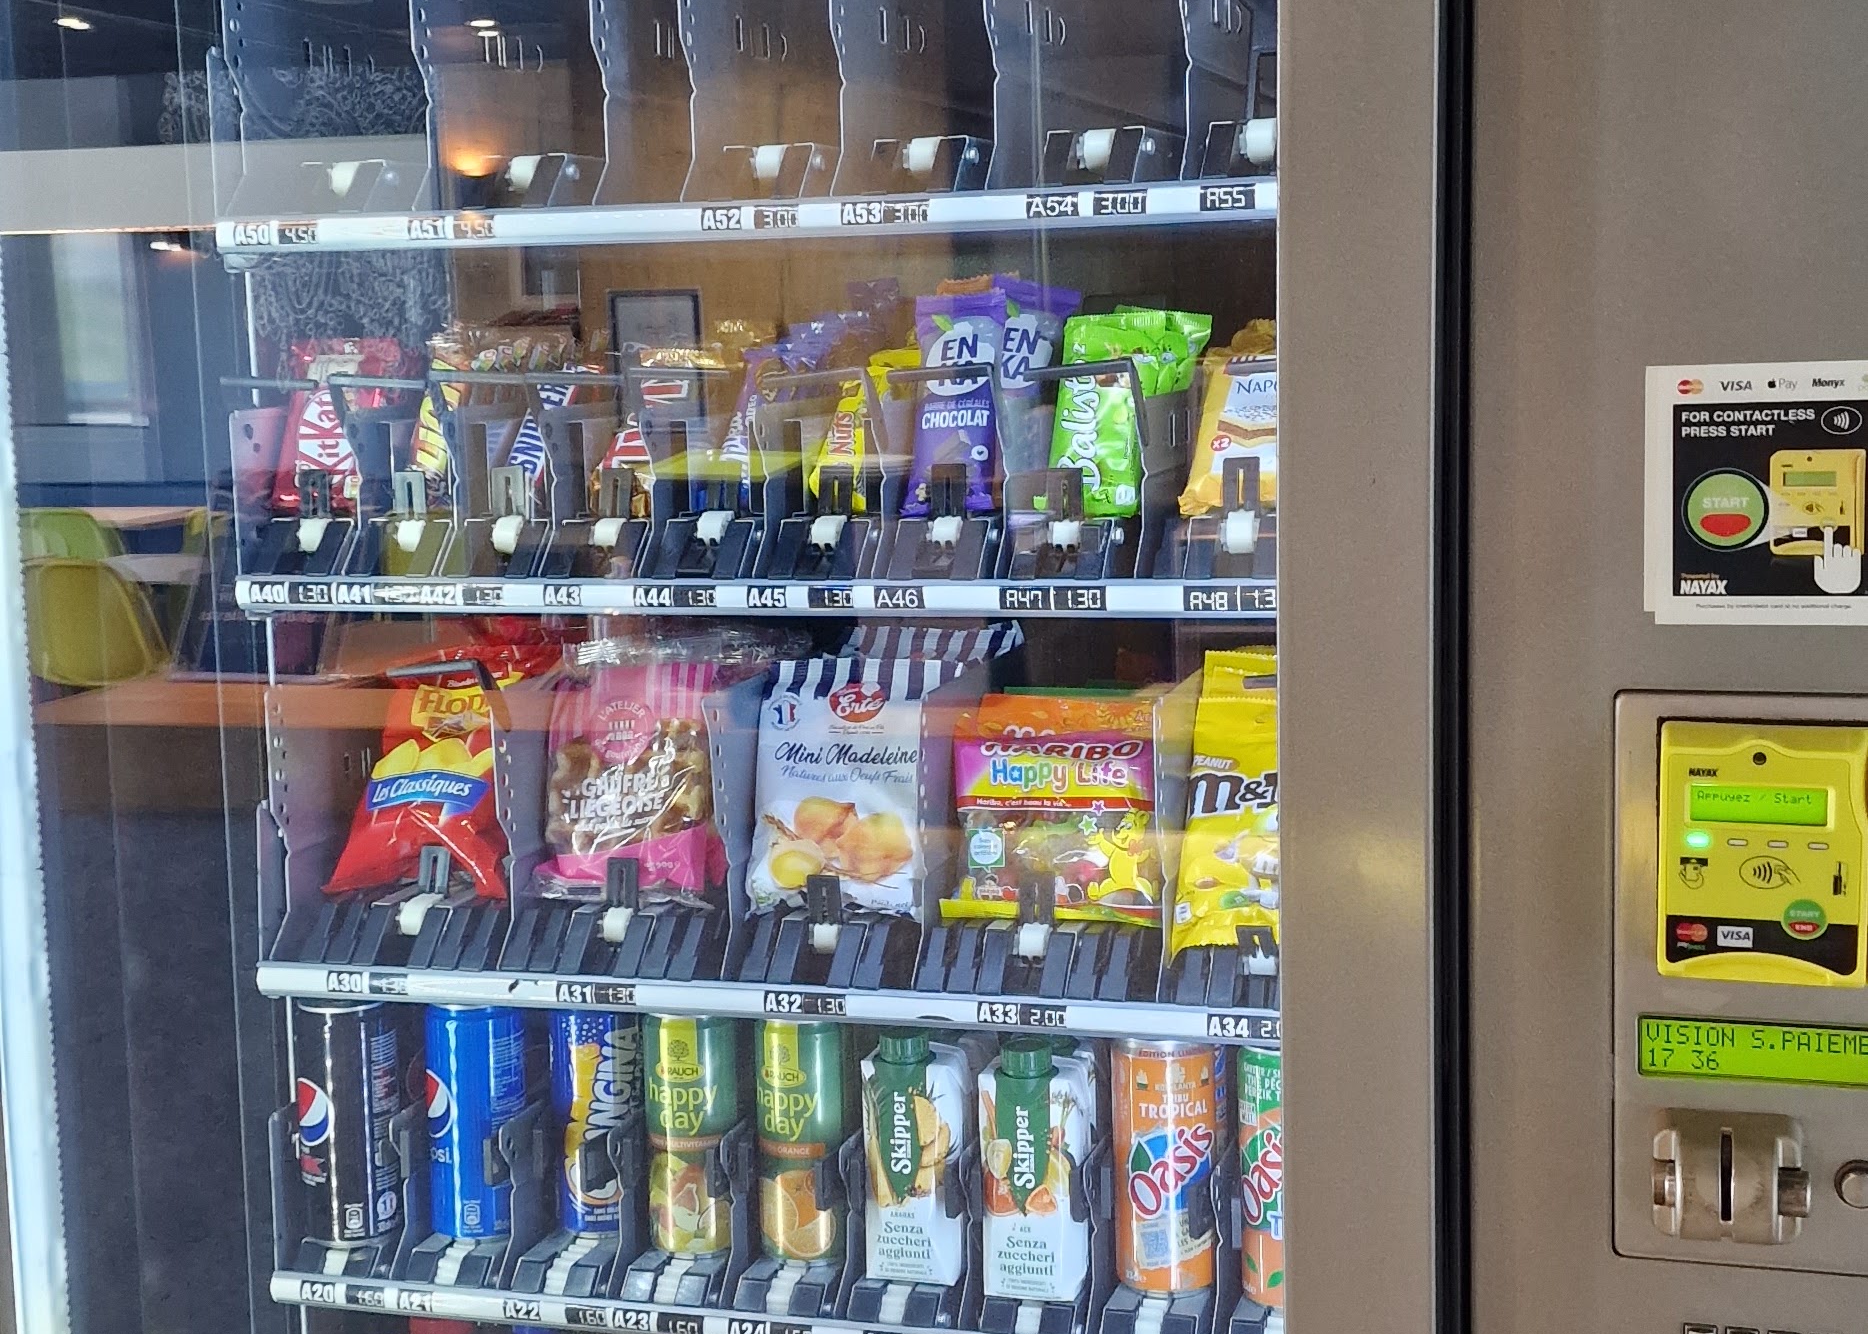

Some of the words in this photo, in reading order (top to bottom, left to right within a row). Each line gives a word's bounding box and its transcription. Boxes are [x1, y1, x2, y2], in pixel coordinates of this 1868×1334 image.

[1028, 195, 1077, 217] A54
[1099, 193, 1146, 214] 3.00
[1205, 186, 1246, 209] A55
[702, 207, 741, 230] A52
[842, 202, 881, 225] A53
[234, 224, 270, 246] A50
[410, 218, 446, 240] A51
[941, 334, 979, 362] EN
[1001, 327, 1041, 356] EN
[1719, 380, 1753, 392] VISA
[1779, 378, 1798, 391] Pay
[1812, 378, 1845, 389] Monyx
[921, 410, 991, 430] CHOCOLAT
[1681, 411, 1710, 423] FOR
[1713, 408, 1816, 423] CONTACTLESS
[1681, 426, 1727, 438] PRESS
[1729, 424, 1776, 437] START
[1701, 497, 1750, 509] START
[250, 583, 285, 603] A40
[337, 584, 372, 604] A41
[420, 584, 456, 605] A42
[544, 588, 580, 606] A43
[1680, 579, 1728, 595] NAYAX
[635, 588, 672, 607] A44
[748, 588, 786, 608] A45
[876, 589, 918, 608] A46
[1066, 590, 1100, 609] 1.30
[1189, 590, 1228, 610] A48
[774, 741, 823, 765] Mini
[825, 743, 918, 766] Madeleine
[1192, 755, 1234, 770] PEANUT
[989, 757, 1069, 793] Happy
[1075, 761, 1128, 786] Life
[1688, 768, 1719, 778] NAYAX
[390, 773, 473, 798] Classiques
[1773, 792, 1813, 806] Start
[1721, 930, 1751, 941] VISA
[328, 973, 363, 993] A30
[558, 984, 593, 1003] A31
[765, 992, 802, 1014] A32
[979, 1004, 1018, 1024] A33
[1029, 1008, 1065, 1027] 2.00
[1208, 1017, 1249, 1038] A34
[1645, 1022, 1735, 1048] VISION
[1751, 1028, 1868, 1056] S.PAIEME
[1648, 1048, 1675, 1068] 17
[1691, 1050, 1720, 1071] 36
[667, 1067, 699, 1077] RAUCH
[648, 1076, 718, 1111] happy
[757, 1078, 820, 1118] happy
[1138, 1098, 1208, 1119] TROPICAL
[659, 1104, 705, 1137] day
[764, 1109, 805, 1142] day
[891, 1090, 913, 1176] Skipper
[777, 1146, 810, 1156] ORANGE
[1013, 1105, 1035, 1190] Skipper
[1128, 1122, 1215, 1220] Oasis
[883, 1221, 924, 1235] Senza
[876, 1234, 932, 1248] zuccheri
[1006, 1235, 1047, 1250] Senza
[878, 1247, 931, 1260] aggiunti
[997, 1250, 1055, 1263] zuccheri
[999, 1263, 1054, 1277] aggiunti
[301, 1282, 335, 1302] A20
[400, 1291, 433, 1312] A21
[505, 1300, 541, 1320] A22
[613, 1309, 649, 1330] A23
